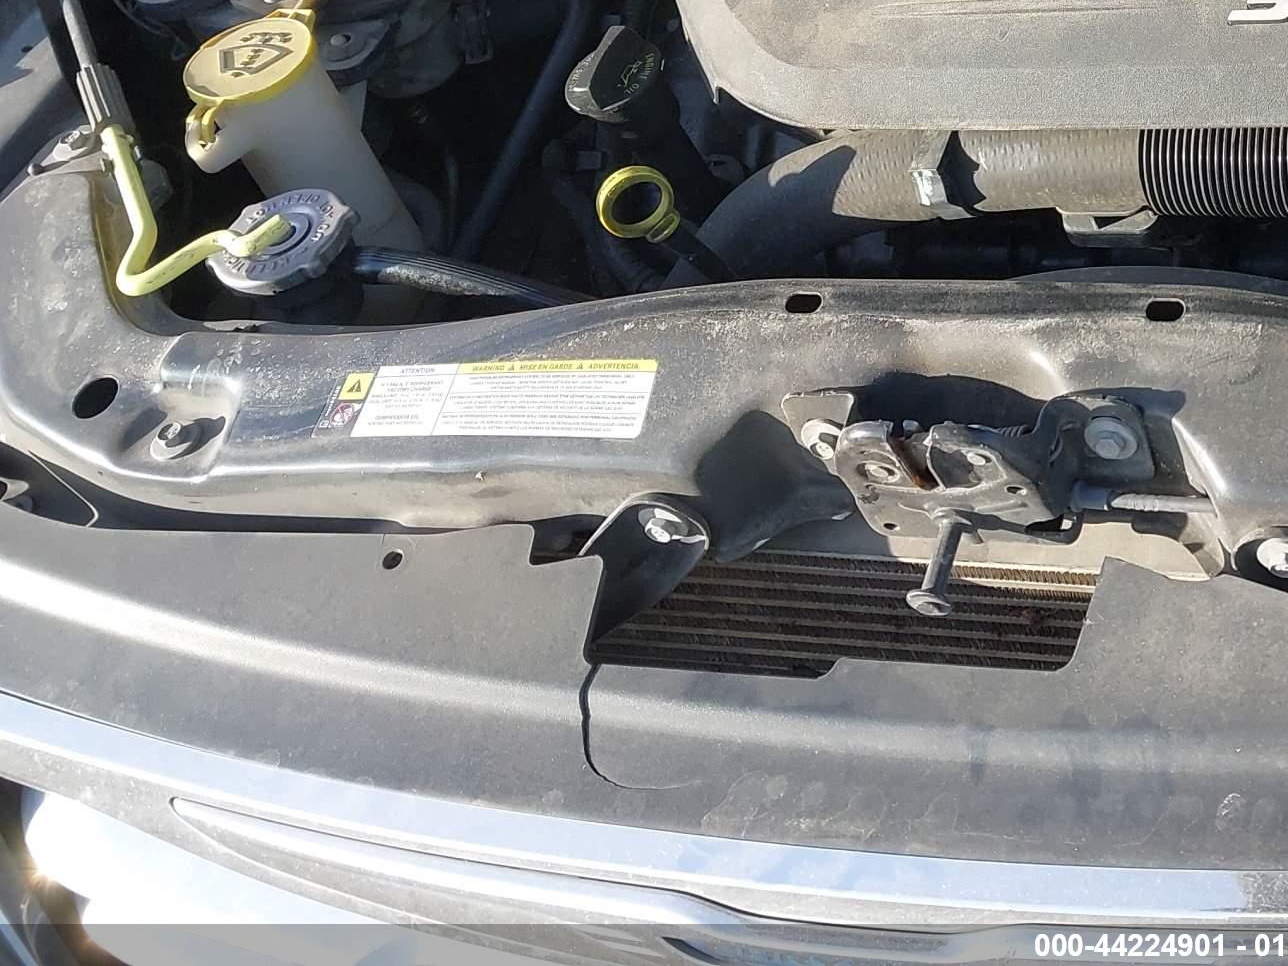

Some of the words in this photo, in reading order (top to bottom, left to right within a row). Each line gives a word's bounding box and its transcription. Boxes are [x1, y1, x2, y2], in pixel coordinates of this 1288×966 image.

[400, 367, 436, 375] ATTENTION
[471, 364, 506, 372] WARNING
[586, 362, 640, 371] ADVERTENCIA
